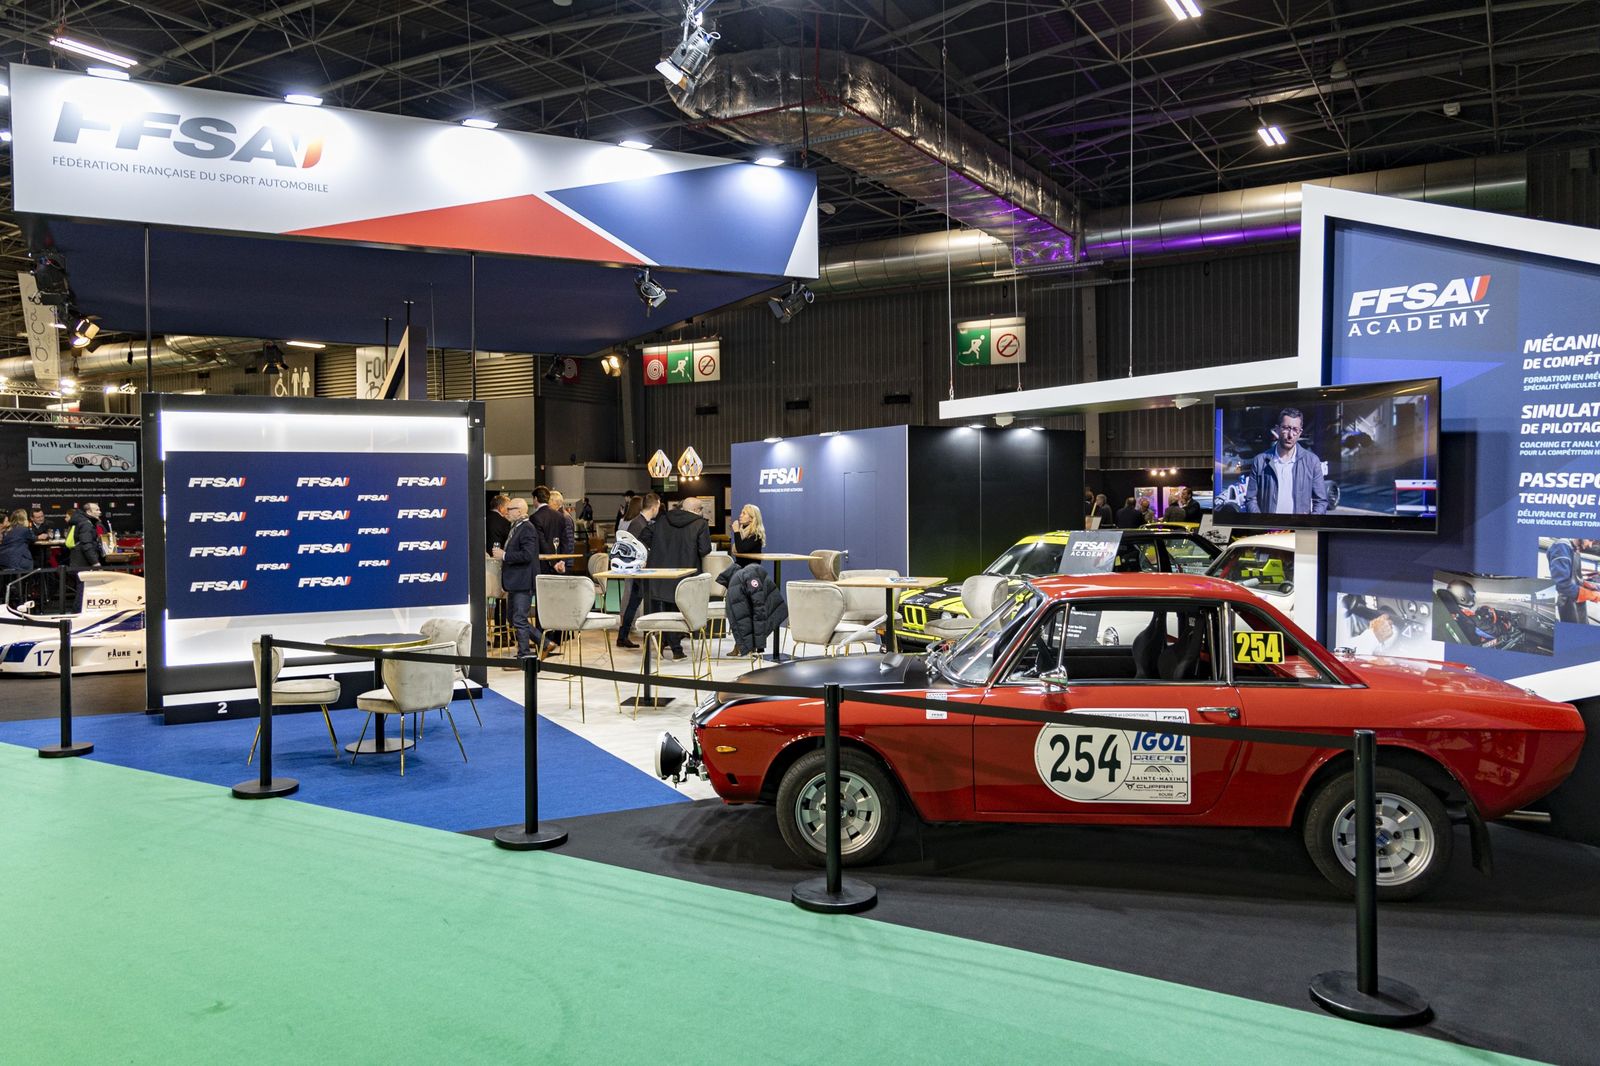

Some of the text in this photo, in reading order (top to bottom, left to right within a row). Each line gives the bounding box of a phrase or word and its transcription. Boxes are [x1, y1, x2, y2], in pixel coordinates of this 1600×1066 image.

[53, 102, 325, 168] FFSA
[52, 155, 329, 193] FÉDÉRATION FRANÇAISE DU SPORT AUTOMOBILE
[1348, 275, 1484, 316] FFSA
[1348, 309, 1490, 337] ACADEMY
[1522, 358, 1542, 370] DE
[1523, 374, 1571, 384] FORMATION
[1573, 373, 1584, 381] EN
[1523, 382, 1560, 391] SPÉCIALITÉ
[1560, 380, 1597, 390] VÉHICULES
[1521, 421, 1600, 435] DE PILOTAG
[31, 440, 113, 450] PostWarClassic.com
[1520, 441, 1560, 449] COACHING
[1547, 447, 1594, 456] COMPÉTITION
[759, 465, 802, 486] FFSA
[188, 477, 245, 488] FFSA
[297, 477, 350, 487] FFSA
[397, 477, 446, 487] FFSA
[255, 495, 288, 503] FFSA
[357, 494, 389, 502] FFSA
[1518, 492, 1596, 508] TECHNIQUE
[189, 511, 244, 523] FFSA
[297, 510, 350, 521] FFSA
[397, 509, 446, 519] FFSA
[1517, 508, 1596, 520] DÉLIVRANCE DE PTH
[1535, 517, 1571, 526] VÉHICULES
[256, 529, 289, 537] FFSA
[358, 527, 389, 535] FFSA
[190, 545, 246, 557] FFSA
[298, 543, 350, 554] FFSA
[398, 540, 446, 551] FFSA
[1071, 541, 1108, 550] FFSA
[256, 562, 289, 571] FFSA
[358, 559, 389, 567] FFSA
[298, 575, 350, 588] FFSA
[398, 572, 447, 584] FFSA
[190, 579, 247, 592] FFSA
[1236, 632, 1281, 664] 254
[34, 650, 55, 666] 17
[217, 702, 228, 714] 2
[1132, 731, 1185, 751] IGOL
[1049, 734, 1122, 782] 254
